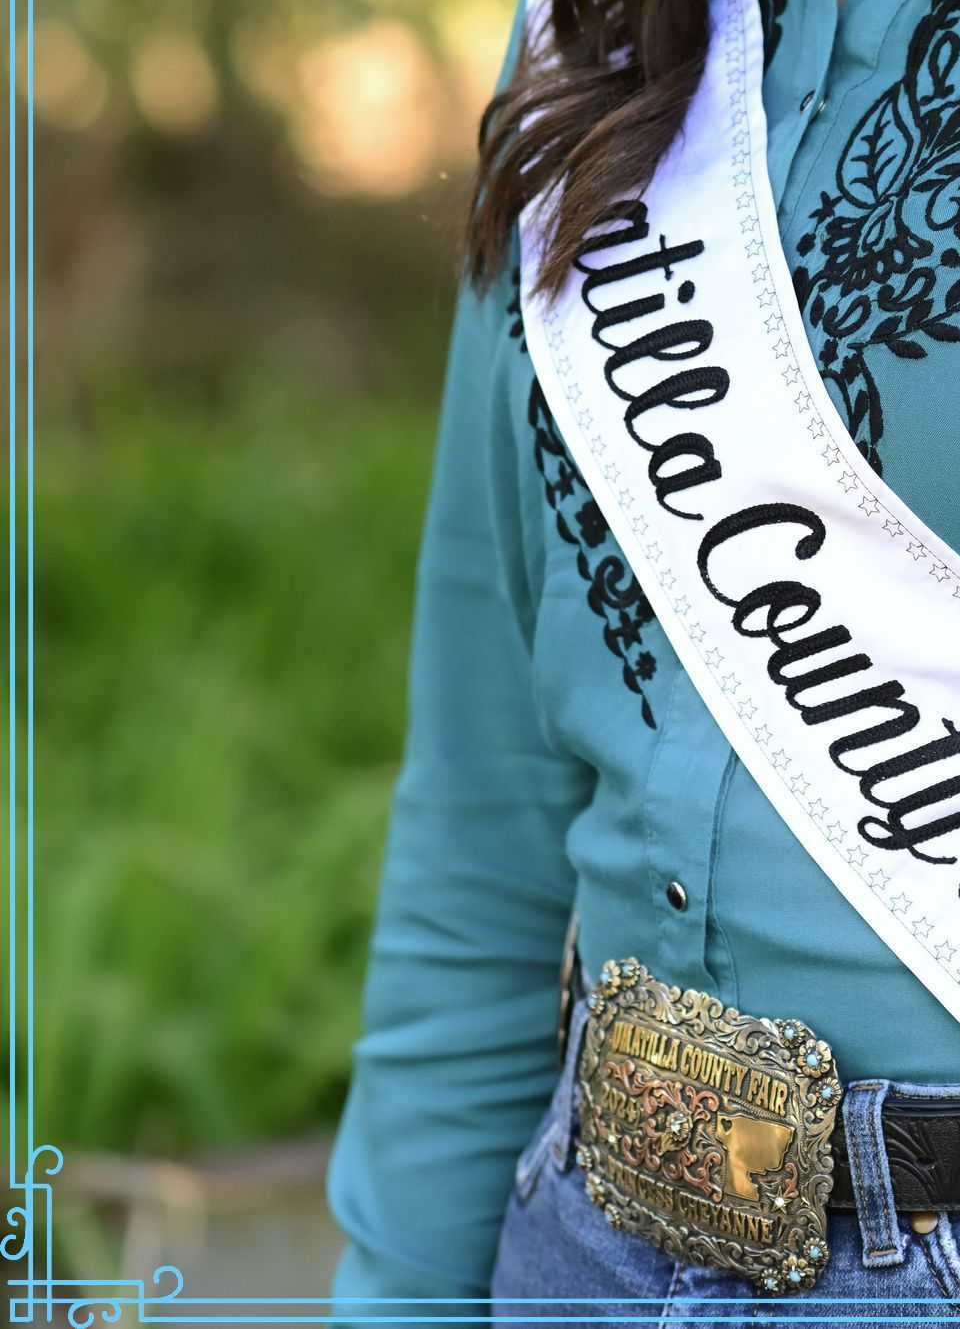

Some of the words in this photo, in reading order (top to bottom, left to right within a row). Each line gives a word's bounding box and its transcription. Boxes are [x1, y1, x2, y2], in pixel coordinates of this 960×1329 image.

[600, 1082, 638, 1124] 2024
[612, 1022, 679, 1070] UMATILLA
[681, 1045, 748, 1095] COUNTY
[749, 1071, 790, 1117] FAIR
[608, 1155, 674, 1209] PRINCESS
[678, 1192, 775, 1245] CHEYANNE
